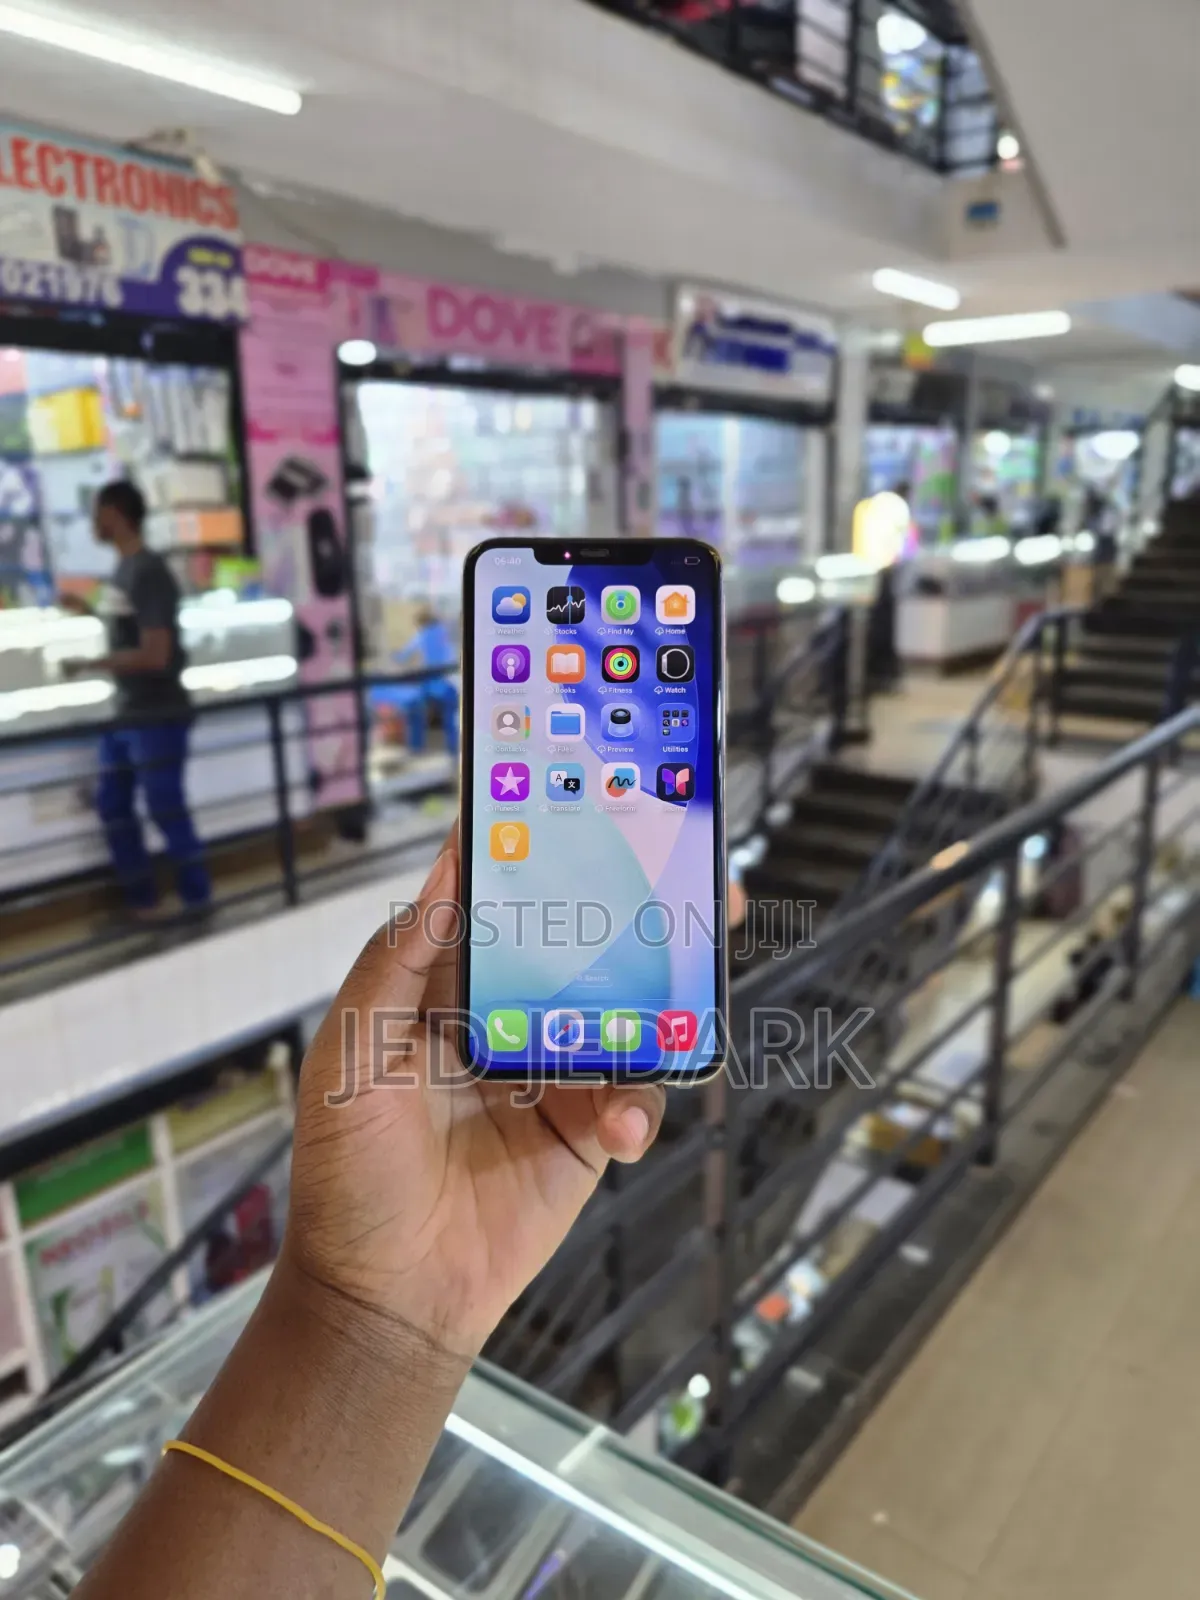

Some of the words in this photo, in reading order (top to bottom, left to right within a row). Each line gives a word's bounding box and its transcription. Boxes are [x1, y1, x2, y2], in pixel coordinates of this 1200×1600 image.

[426, 284, 560, 353] DOVE
[554, 627, 577, 635] Stocks
[623, 628, 635, 636] My
[664, 686, 686, 694] Watch
